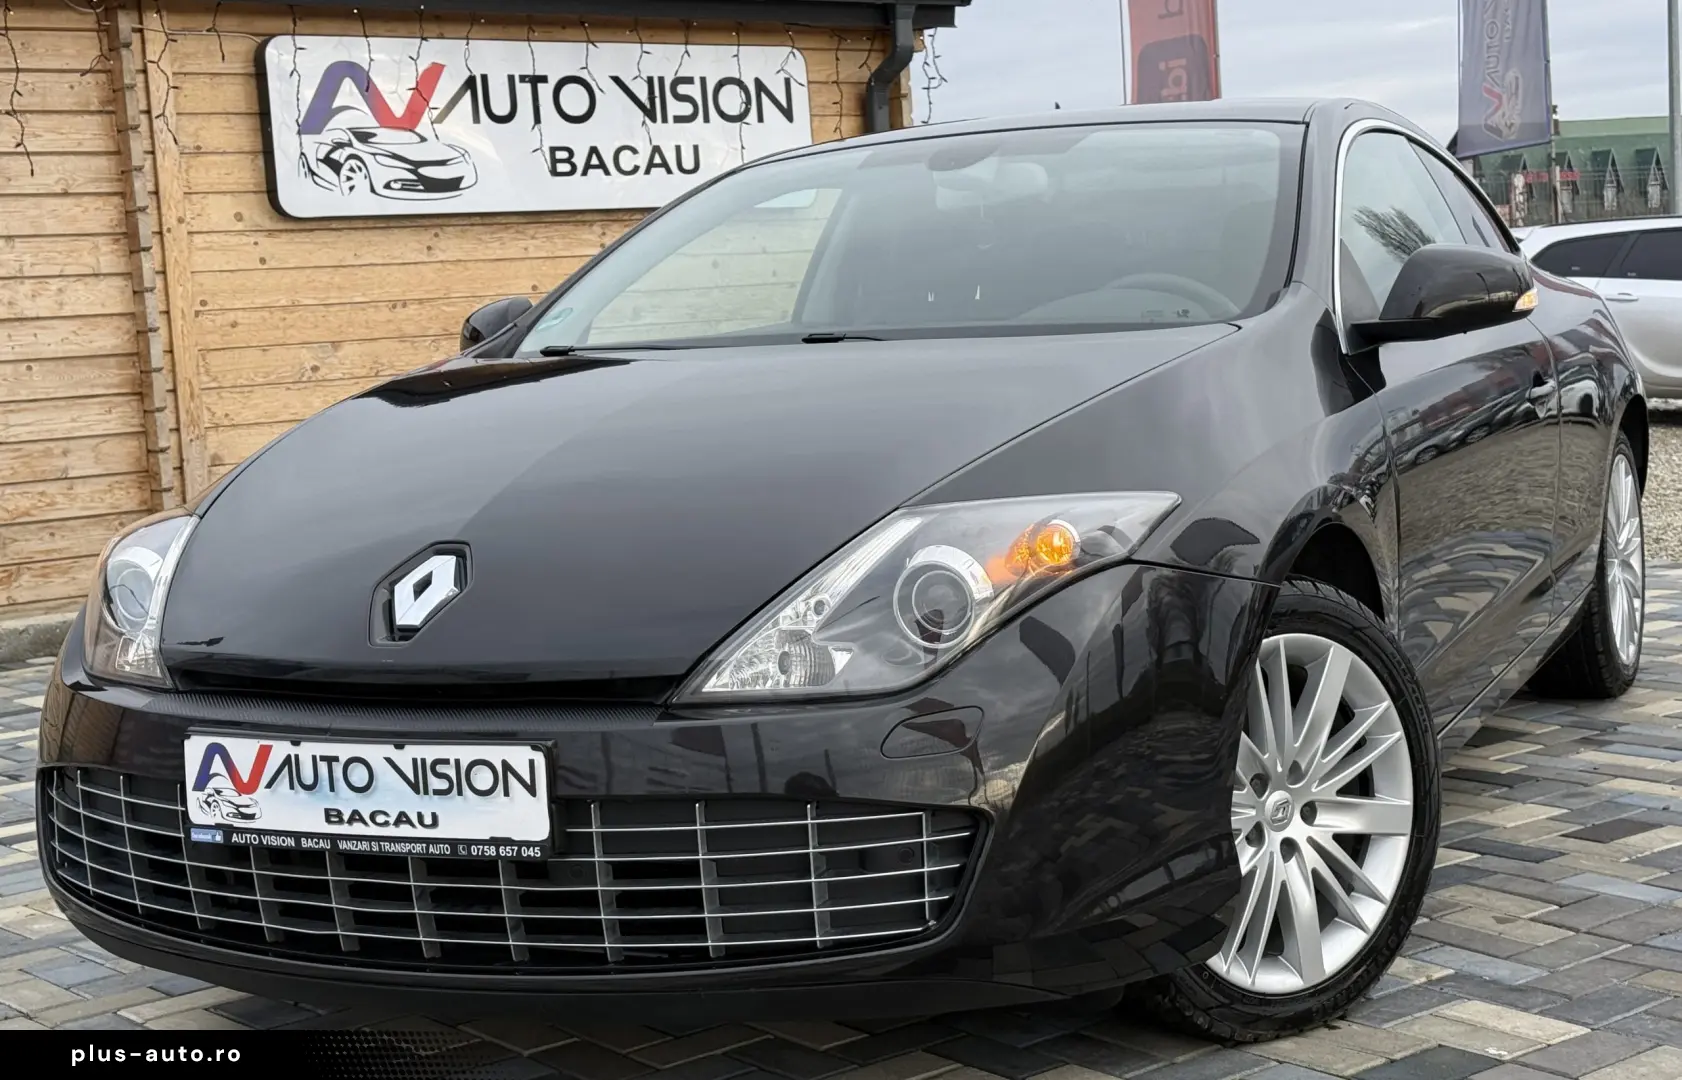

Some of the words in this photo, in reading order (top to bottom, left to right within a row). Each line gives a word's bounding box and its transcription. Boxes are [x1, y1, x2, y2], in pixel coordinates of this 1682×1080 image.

[1485, 20, 1503, 91] AUTO
[433, 73, 597, 125] AUTO
[609, 74, 794, 125] VISION
[550, 143, 700, 177] BACAU
[264, 753, 375, 794] AUTO
[383, 756, 537, 798] VISION
[324, 807, 439, 829] BACAU
[231, 832, 259, 845] AUTO
[262, 835, 296, 847] VISION
[301, 838, 331, 849] BACAU
[337, 840, 371, 851] VANZARI
[371, 841, 379, 851] SI
[379, 842, 427, 854] TRANSPORT
[429, 844, 451, 855] AUTO
[471, 845, 496, 856] 0758
[499, 846, 518, 857] 657
[521, 846, 541, 858] 045
